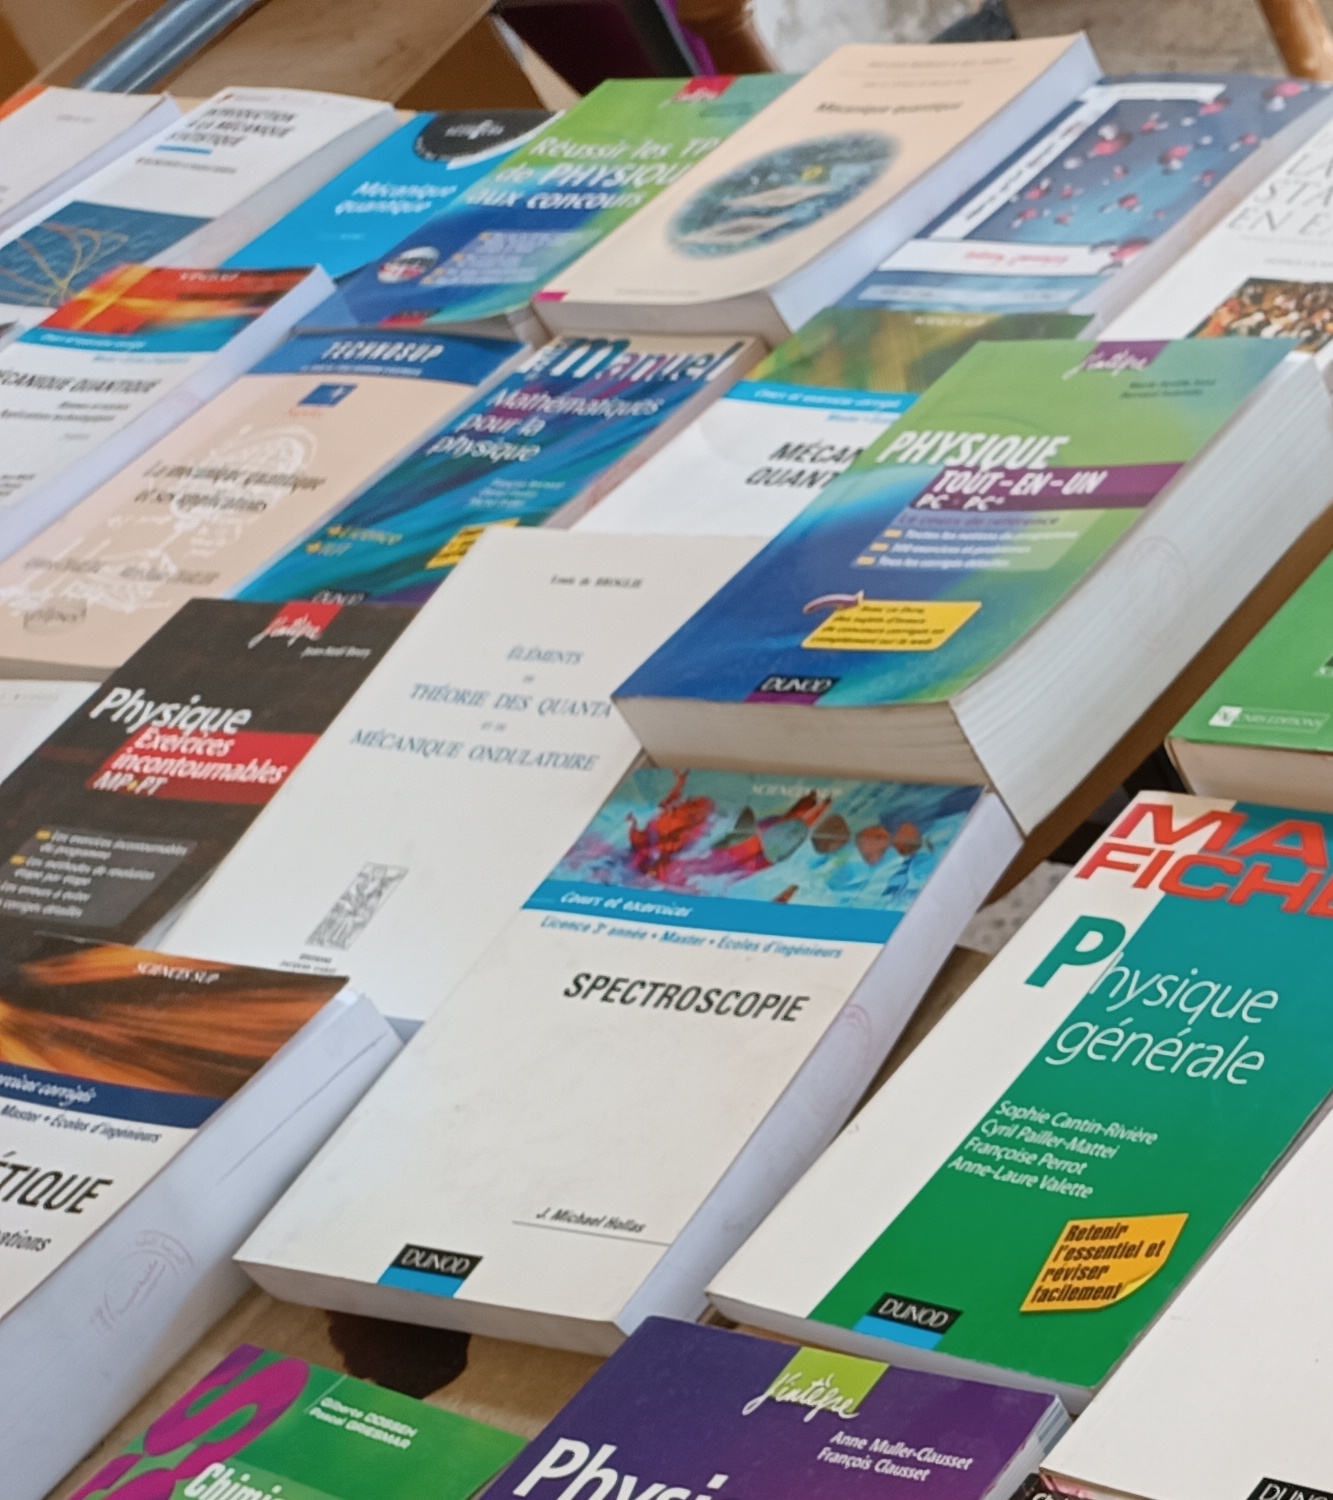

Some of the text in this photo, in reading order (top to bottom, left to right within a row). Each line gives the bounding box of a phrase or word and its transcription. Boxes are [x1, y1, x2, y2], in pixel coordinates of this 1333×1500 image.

[874, 431, 1070, 472] PHYSIQUE
[89, 686, 252, 735] Physique
[408, 681, 613, 719] THÉORIE DES QUANTA
[110, 747, 288, 784] incontournables
[349, 726, 599, 772] MÉCANIQUE ONDULATOIRE
[1022, 912, 1281, 1027] Physique
[563, 972, 811, 1024] SPECTROSCOPIE
[1044, 1014, 1266, 1088] générale
[995, 1100, 1158, 1145] Sophie Cantin-Rivière
[553, 1211, 601, 1231] Michael
[604, 1218, 646, 1234] Hollas
[1063, 1222, 1129, 1243] Retenir
